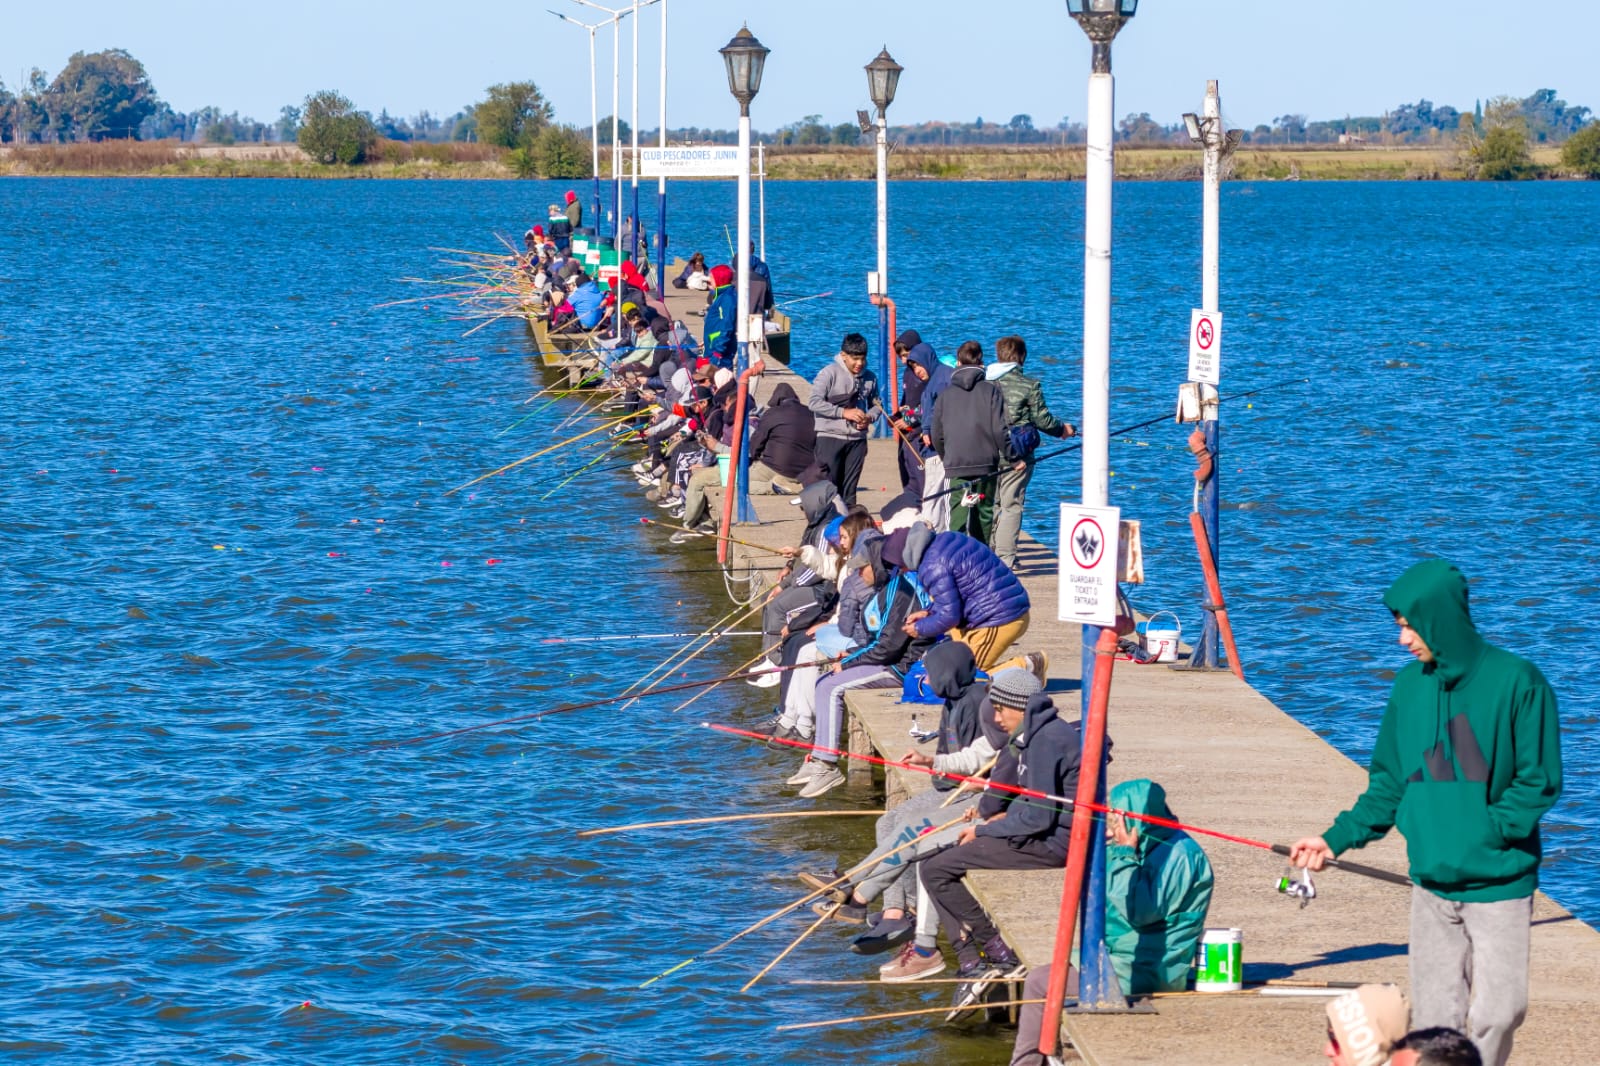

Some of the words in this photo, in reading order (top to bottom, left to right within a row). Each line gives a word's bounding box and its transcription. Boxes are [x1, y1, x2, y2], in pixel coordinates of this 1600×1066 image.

[643, 150, 662, 160] CLUB
[663, 150, 711, 160] PESCADORES
[1070, 574, 1095, 584] GUARDAR
[1096, 576, 1103, 585] EL
[1075, 585, 1093, 595] TICKET
[1074, 596, 1098, 606] ENTRADA
